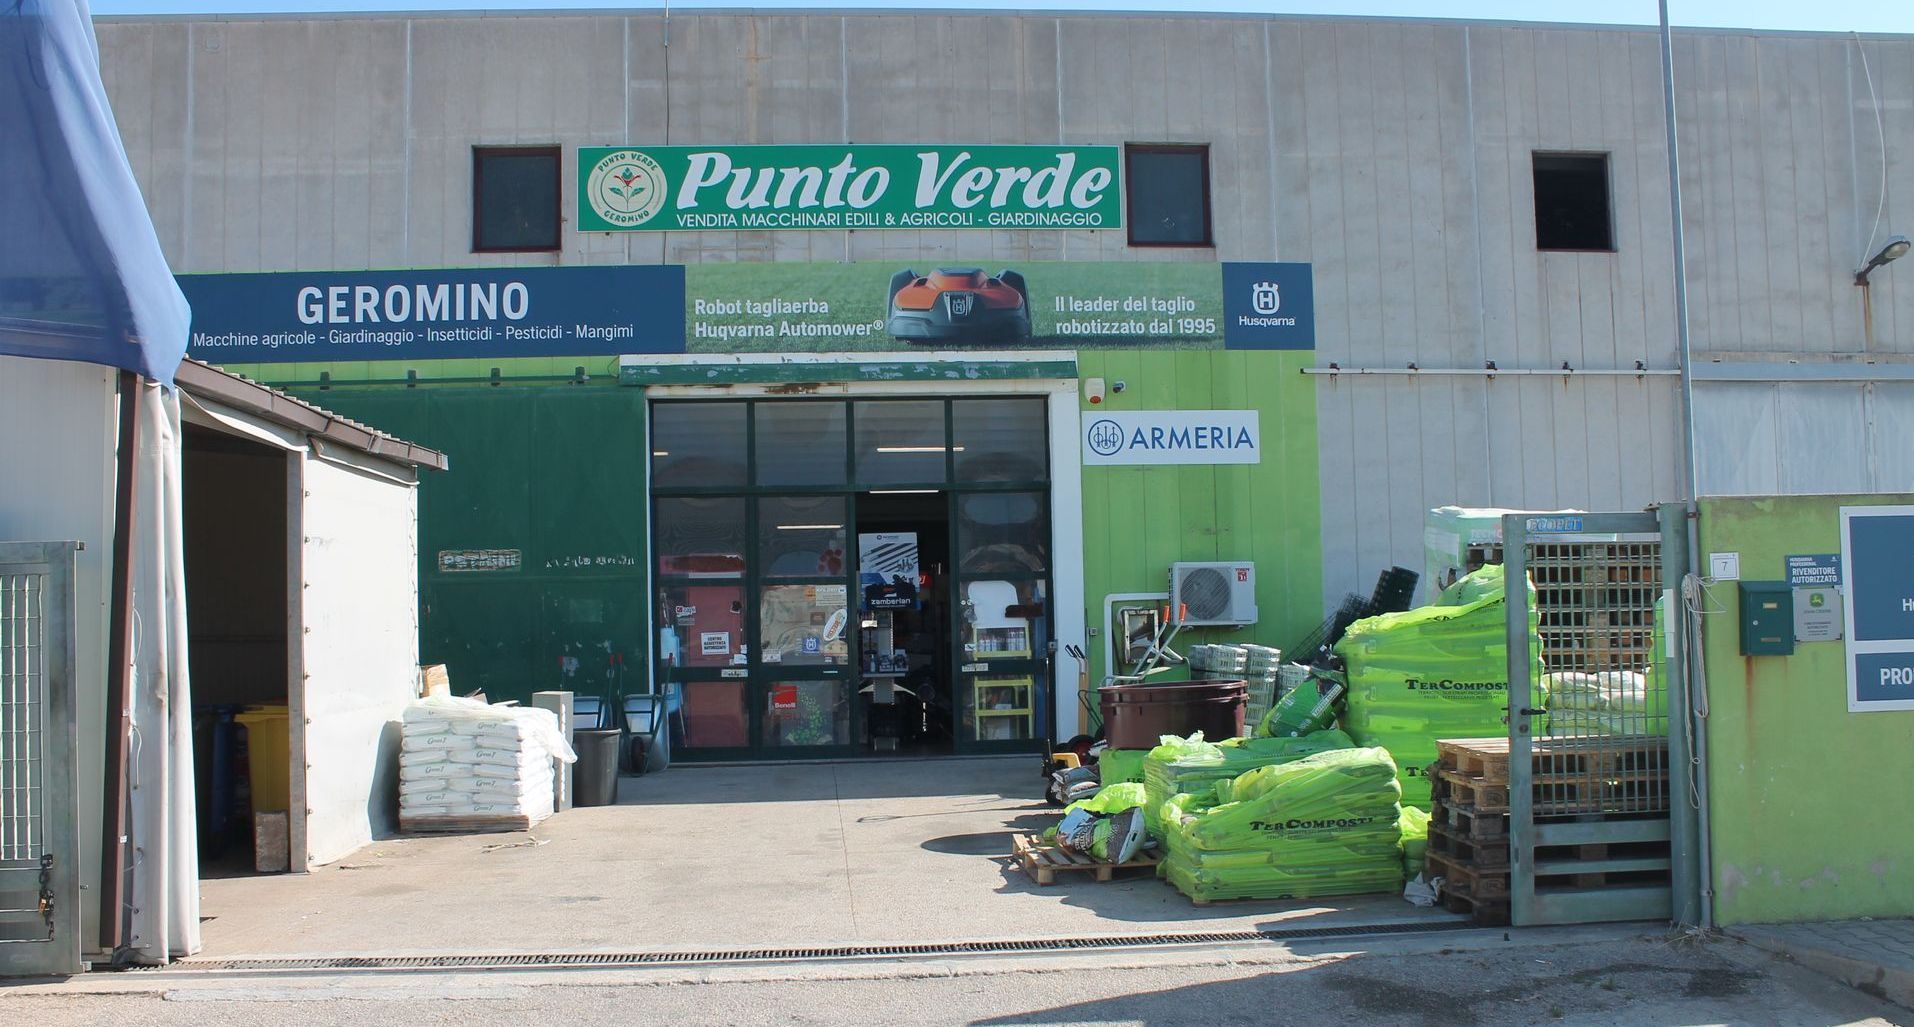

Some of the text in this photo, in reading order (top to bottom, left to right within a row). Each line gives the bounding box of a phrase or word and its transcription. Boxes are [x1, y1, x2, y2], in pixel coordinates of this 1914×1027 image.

[597, 152, 659, 173] PUNTO VERDE
[676, 151, 1112, 210] Punto Verde
[603, 210, 651, 224] GEROMINO
[676, 213, 738, 227] VENDITA
[742, 213, 840, 226] MACCHINARI
[845, 213, 880, 225] EDILI
[884, 213, 896, 225] &
[899, 213, 973, 226] AGRICOLI
[988, 212, 1102, 226] GIARDINAGGIO
[297, 282, 529, 325] GEROMINO
[695, 299, 829, 317] Robot tagliaerba
[1069, 297, 1119, 312] leader
[1123, 297, 1147, 312] del
[1151, 296, 1195, 315] taglio
[1056, 319, 1216, 335] robotizzato dal 1995
[1238, 315, 1296, 328] Husqvarna
[193, 332, 258, 347] Macchine
[262, 331, 316, 348] agricole
[329, 329, 414, 345] Giardinaggio
[427, 327, 492, 342] Insetticidi
[505, 325, 563, 340] Pesticidi
[575, 323, 634, 342] Mangimi
[695, 322, 774, 340] Huqvarna
[1129, 426, 1254, 450] ARMERIA
[1721, 561, 1728, 571] 7
[1792, 567, 1837, 576] RIVENDITORE
[1791, 575, 1838, 584] AUTORIZZATO
